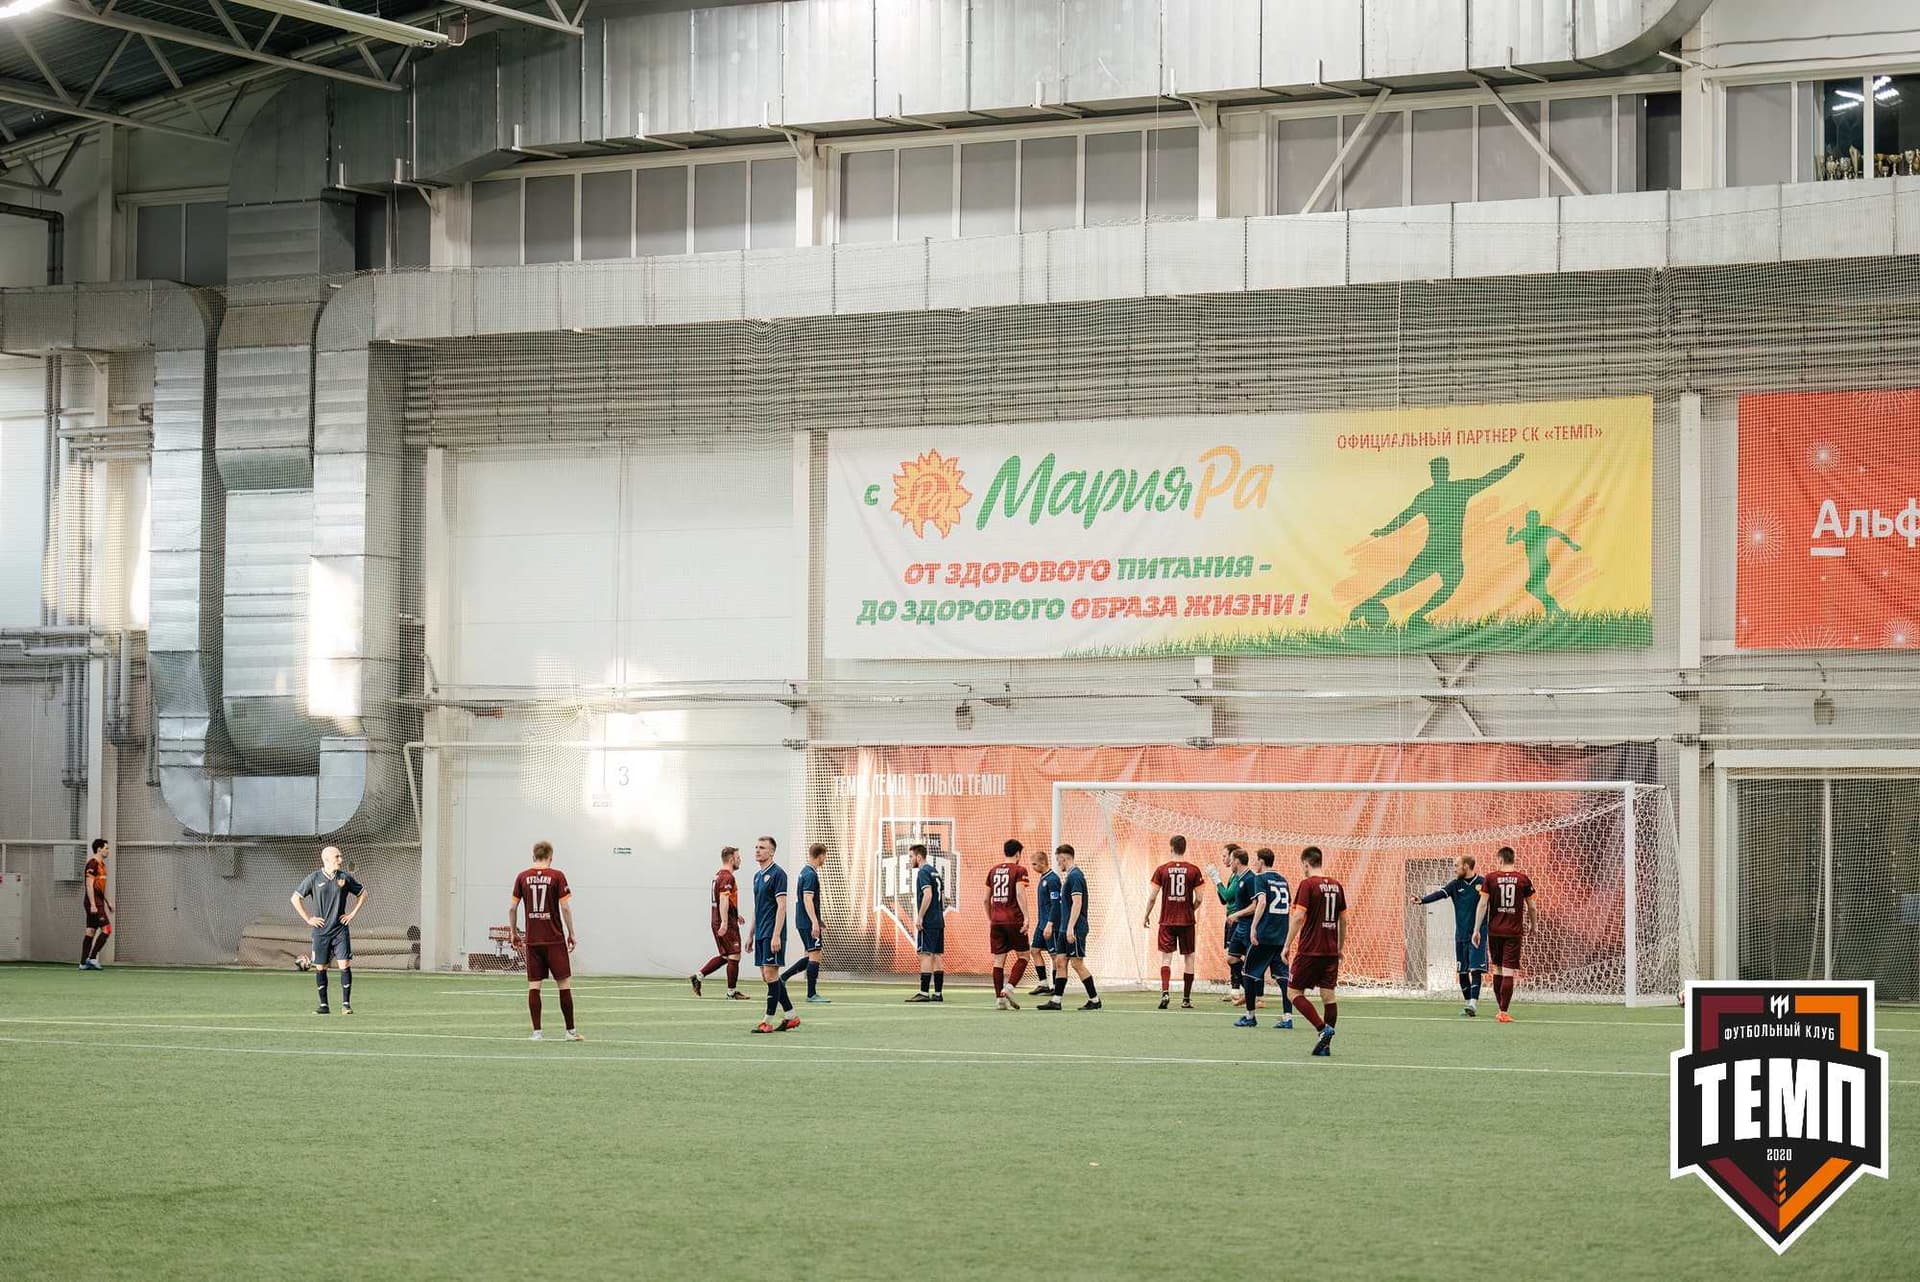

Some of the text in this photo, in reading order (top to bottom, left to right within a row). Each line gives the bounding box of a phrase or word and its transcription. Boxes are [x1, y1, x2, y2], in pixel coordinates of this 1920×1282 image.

[1337, 428, 1451, 452] ОФИЦИАЛЬНЫЙ
[1457, 428, 1517, 446] ПАРТНЕР
[1522, 427, 1540, 442] СК
[1812, 497, 1920, 548] Альф
[904, 562, 941, 584] ОТ
[945, 559, 1111, 588] ЗДОРОВОГО
[1117, 555, 1255, 580] ПИТАНИЯ
[856, 600, 897, 625] ДО
[901, 598, 1066, 625] ЗДОРОВОГО
[1070, 595, 1178, 620] ОБРАЗА
[618, 766, 630, 786] 3
[914, 774, 963, 796] ТОЛЬКО
[967, 774, 1006, 796] ТЕМП!
[530, 884, 548, 912] 17
[993, 874, 1010, 898] 22
[1169, 873, 1186, 897] 18
[1498, 883, 1516, 907] 19
[1269, 886, 1289, 914] 23
[1324, 893, 1337, 921] 11
